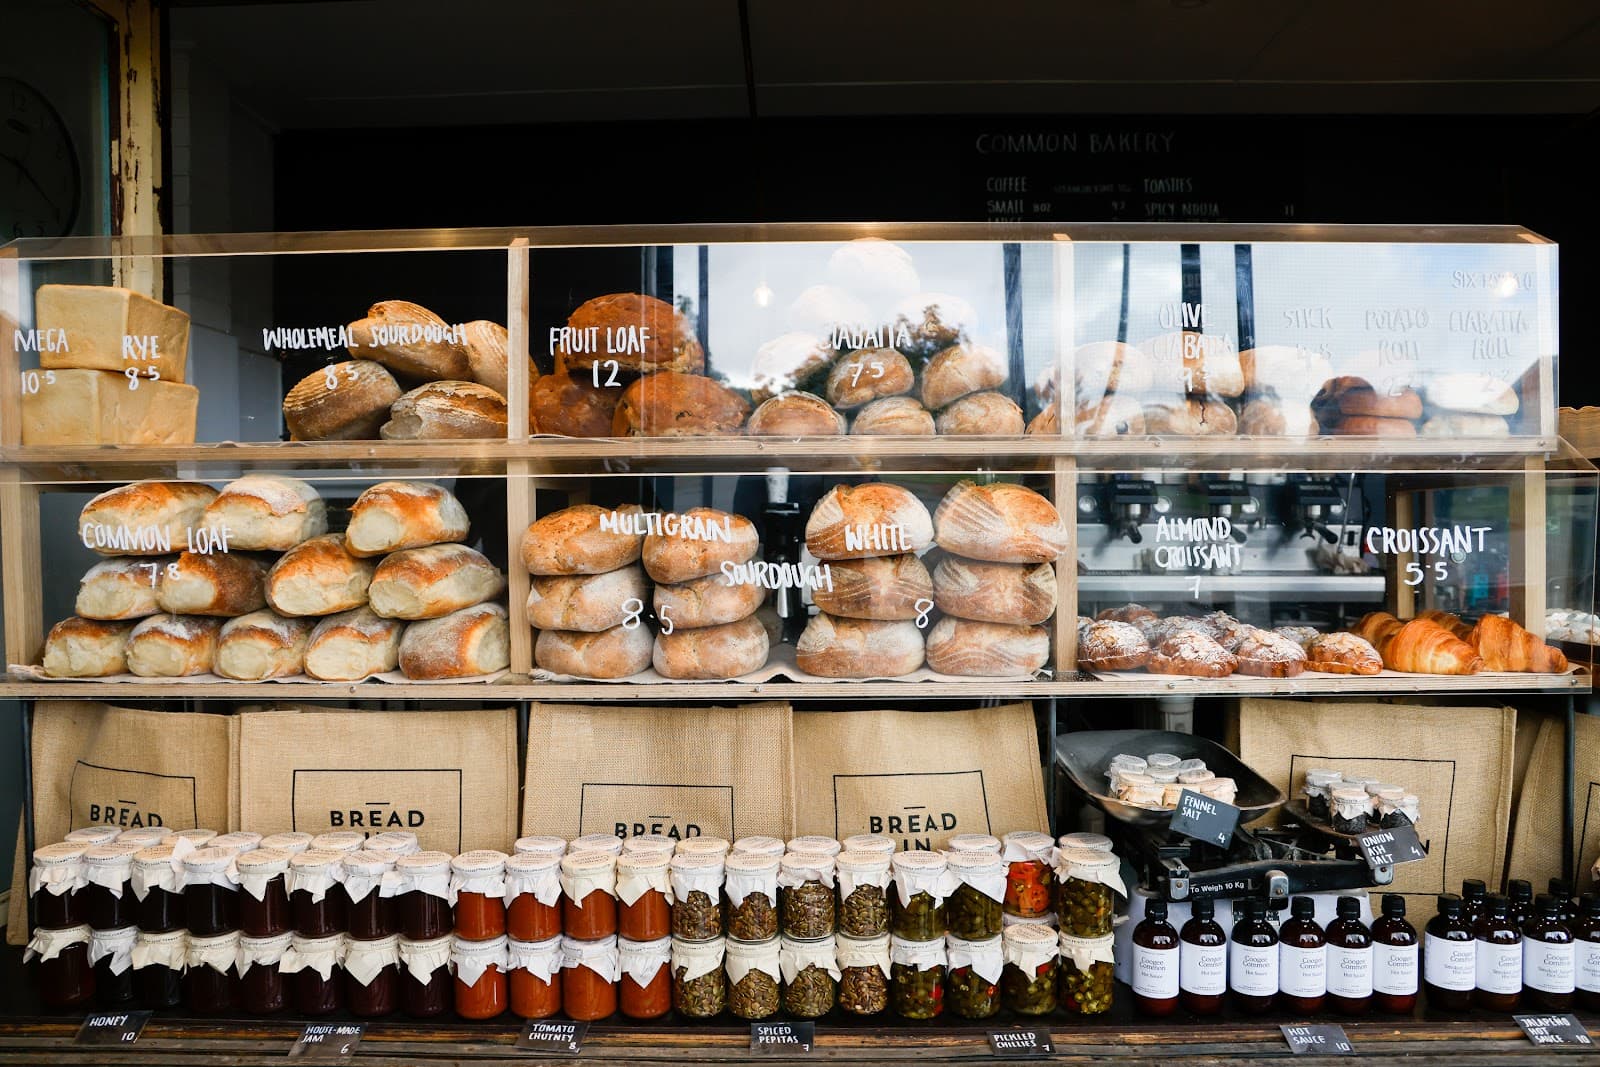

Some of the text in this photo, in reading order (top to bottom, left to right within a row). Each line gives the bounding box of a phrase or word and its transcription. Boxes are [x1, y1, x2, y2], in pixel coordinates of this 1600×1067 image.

[975, 131, 1176, 154] COMMON BAKERY
[986, 177, 1028, 193] COFFEE
[1144, 177, 1193, 193] TOASTIES
[986, 199, 1024, 214] SMALL
[1144, 201, 1175, 217] SPICY
[1451, 270, 1477, 289] SIX
[1158, 302, 1214, 329] OLIVE
[1282, 307, 1335, 330] STICK
[1365, 308, 1430, 333] POTATO
[1449, 309, 1528, 335] CIABATTA
[14, 328, 70, 354] MEGA
[262, 322, 469, 351] WHOLEMEAL SOURDOUGH
[549, 326, 651, 356] FRUIT LOAF
[122, 334, 161, 361] RYE
[1378, 339, 1420, 367] ROLL
[1472, 337, 1515, 360] ROLL
[592, 359, 623, 389] 12
[599, 511, 732, 543] MULTIGRAIN
[1155, 515, 1232, 543] ALMOND
[82, 522, 234, 555] COMMON LOAF
[844, 523, 913, 552] WHITE
[1366, 525, 1493, 557] CROISSANT
[1153, 543, 1243, 570] CROISSANT
[719, 560, 834, 593] SOURDOUGH
[1183, 575, 1202, 600] 7
[914, 598, 935, 629] 8
[1181, 806, 1202, 820] SALT
[1184, 795, 1217, 816] FENNEL
[89, 803, 164, 828] BREAD
[329, 810, 425, 828] BREAD
[869, 812, 958, 834] BREAD
[614, 822, 701, 842] BREAD
[1218, 832, 1226, 844] 4
[1362, 832, 1395, 847] ONION
[904, 837, 932, 851] IN
[1367, 845, 1387, 857] ASH
[1410, 846, 1420, 857] 4
[1371, 853, 1394, 865] SALT
[1201, 883, 1224, 892] Weigh
[1234, 881, 1245, 889] Kg
[89, 1014, 129, 1027] HONEY
[532, 1023, 576, 1033] TOMATO
[121, 1031, 136, 1041] 10
[300, 1034, 325, 1043] JAM
[305, 1026, 361, 1035] HOUSE-MADE
[528, 1032, 574, 1043] CHUTNEY
[757, 1026, 792, 1035] SPICED
[992, 1032, 1036, 1042] PICKLED
[1287, 1027, 1311, 1036] HOT
[1527, 1027, 1549, 1036] HOT
[758, 1035, 799, 1044] PEPITAS
[802, 1043, 810, 1052] 7
[996, 1040, 1037, 1049] CHILLIES
[1293, 1035, 1326, 1045] SAUCE
[1335, 1042, 1351, 1051] 10
[1534, 1035, 1564, 1044] SAUCE
[1575, 1035, 1591, 1044] 10
[340, 1043, 350, 1054] 6
[1041, 1044, 1050, 1052] 7
